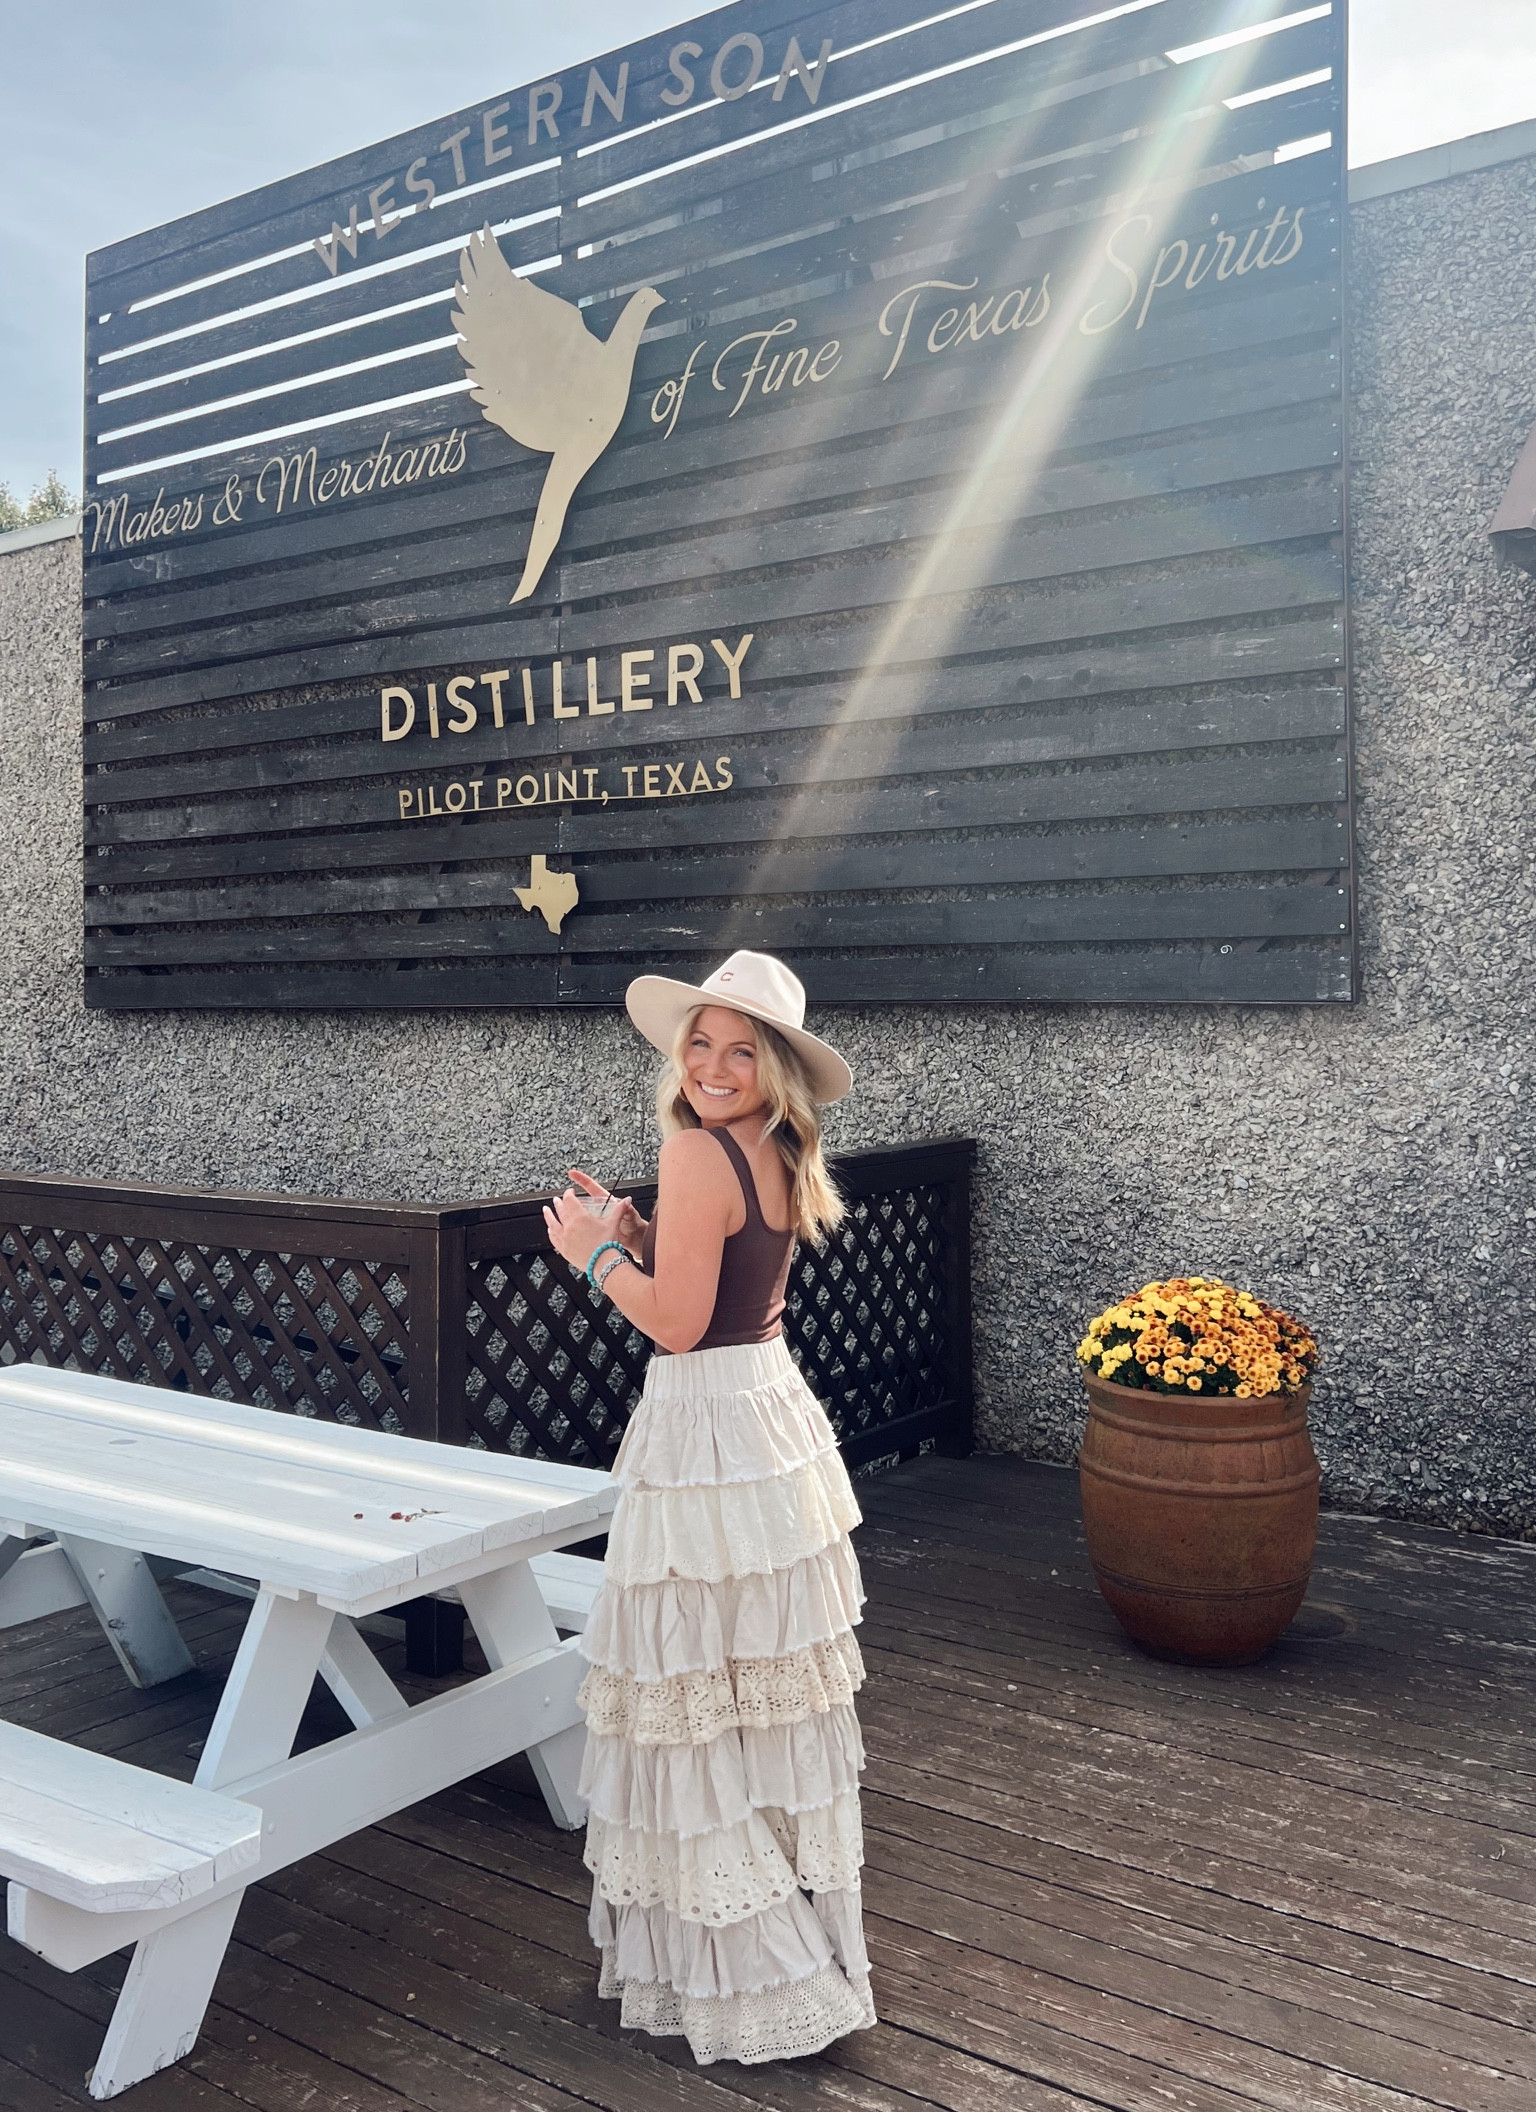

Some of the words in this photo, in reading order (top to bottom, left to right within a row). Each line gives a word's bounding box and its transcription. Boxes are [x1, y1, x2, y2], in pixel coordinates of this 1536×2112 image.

[311, 61, 629, 277] WESTERN
[659, 31, 833, 106] SON
[77, 487, 205, 554] Makers
[212, 474, 243, 526] &
[256, 428, 468, 514] Merchants
[651, 339, 706, 441] of
[712, 318, 842, 419] Fine
[879, 276, 1052, 381] Texas
[1079, 197, 1306, 335] Spirits
[381, 633, 754, 742] DISTILLERY
[398, 780, 484, 820] PILOT
[497, 768, 609, 808] POINT,
[621, 756, 733, 798] TEXAS
